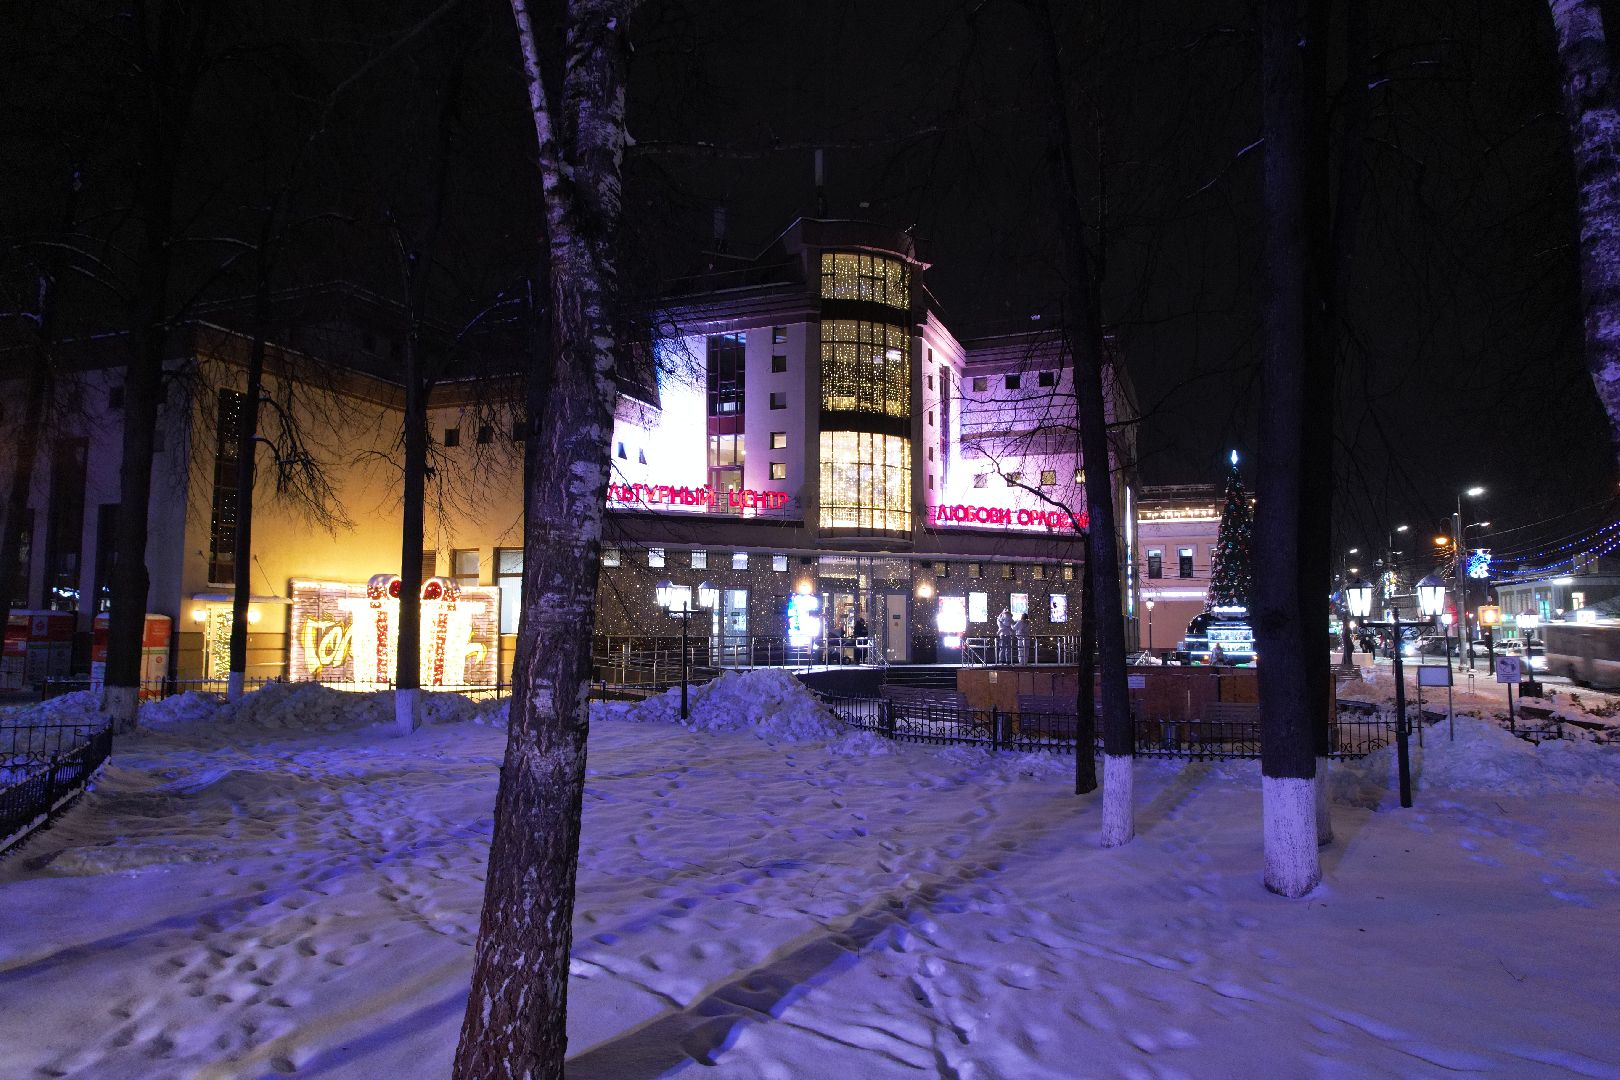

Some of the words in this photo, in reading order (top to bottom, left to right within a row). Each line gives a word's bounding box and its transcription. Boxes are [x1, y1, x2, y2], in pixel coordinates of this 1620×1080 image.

[607, 481, 715, 506] ЛЬТУРНЫЙ
[728, 488, 789, 510] ЦЕНТР
[937, 504, 1011, 525] ЛЮБОВИ
